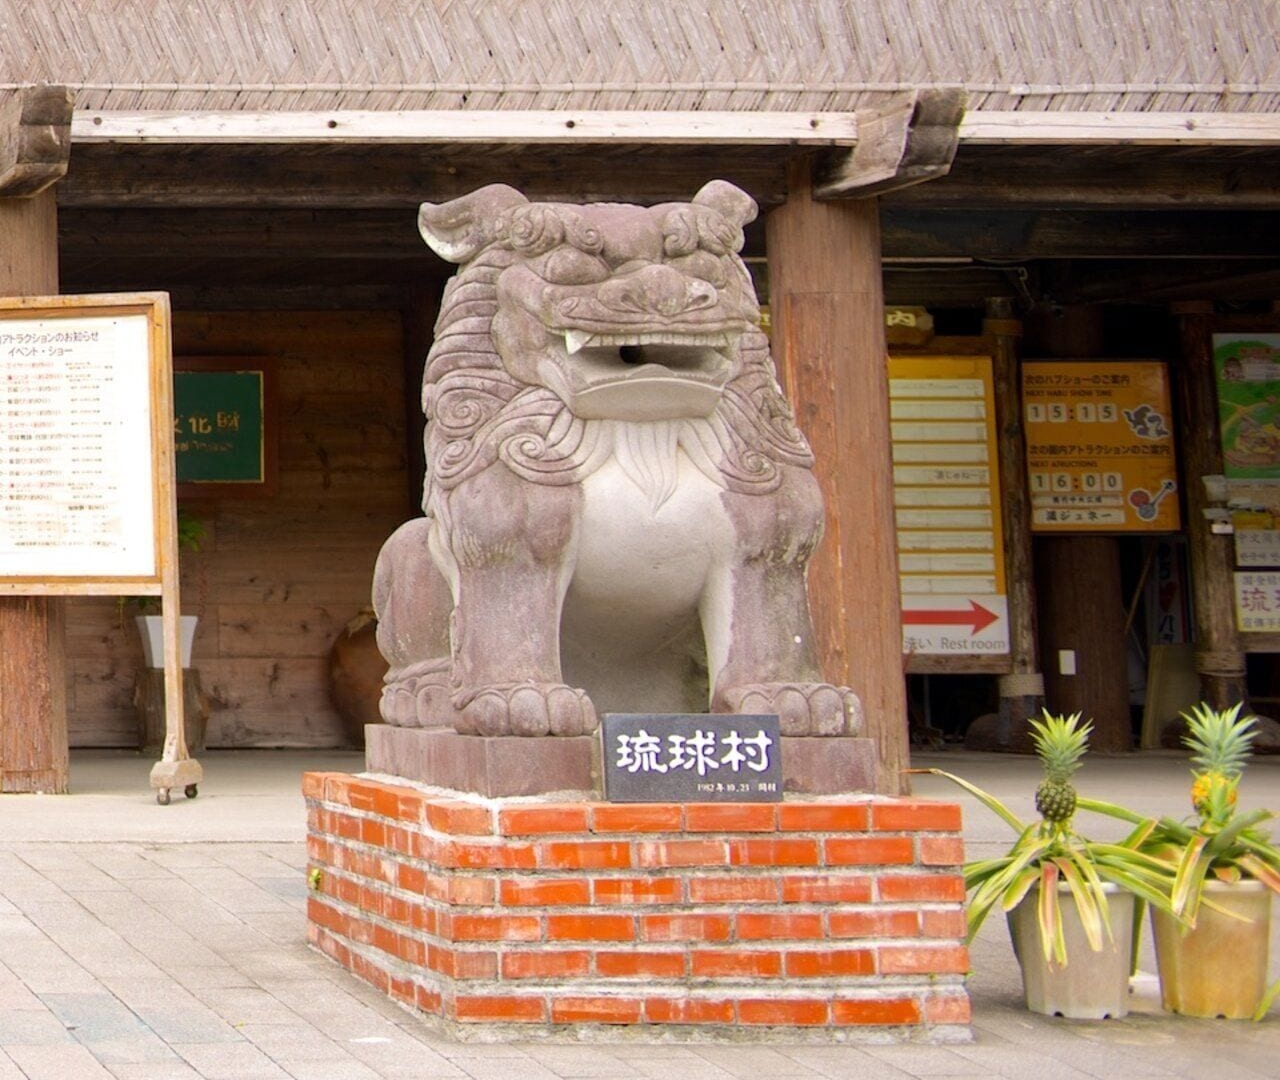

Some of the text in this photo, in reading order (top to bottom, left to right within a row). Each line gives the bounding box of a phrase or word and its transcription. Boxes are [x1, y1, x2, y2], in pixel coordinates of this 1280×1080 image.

[940, 637, 968, 650] Rest
[971, 639, 1006, 650] room
[616, 730, 773, 776] 琉球村
